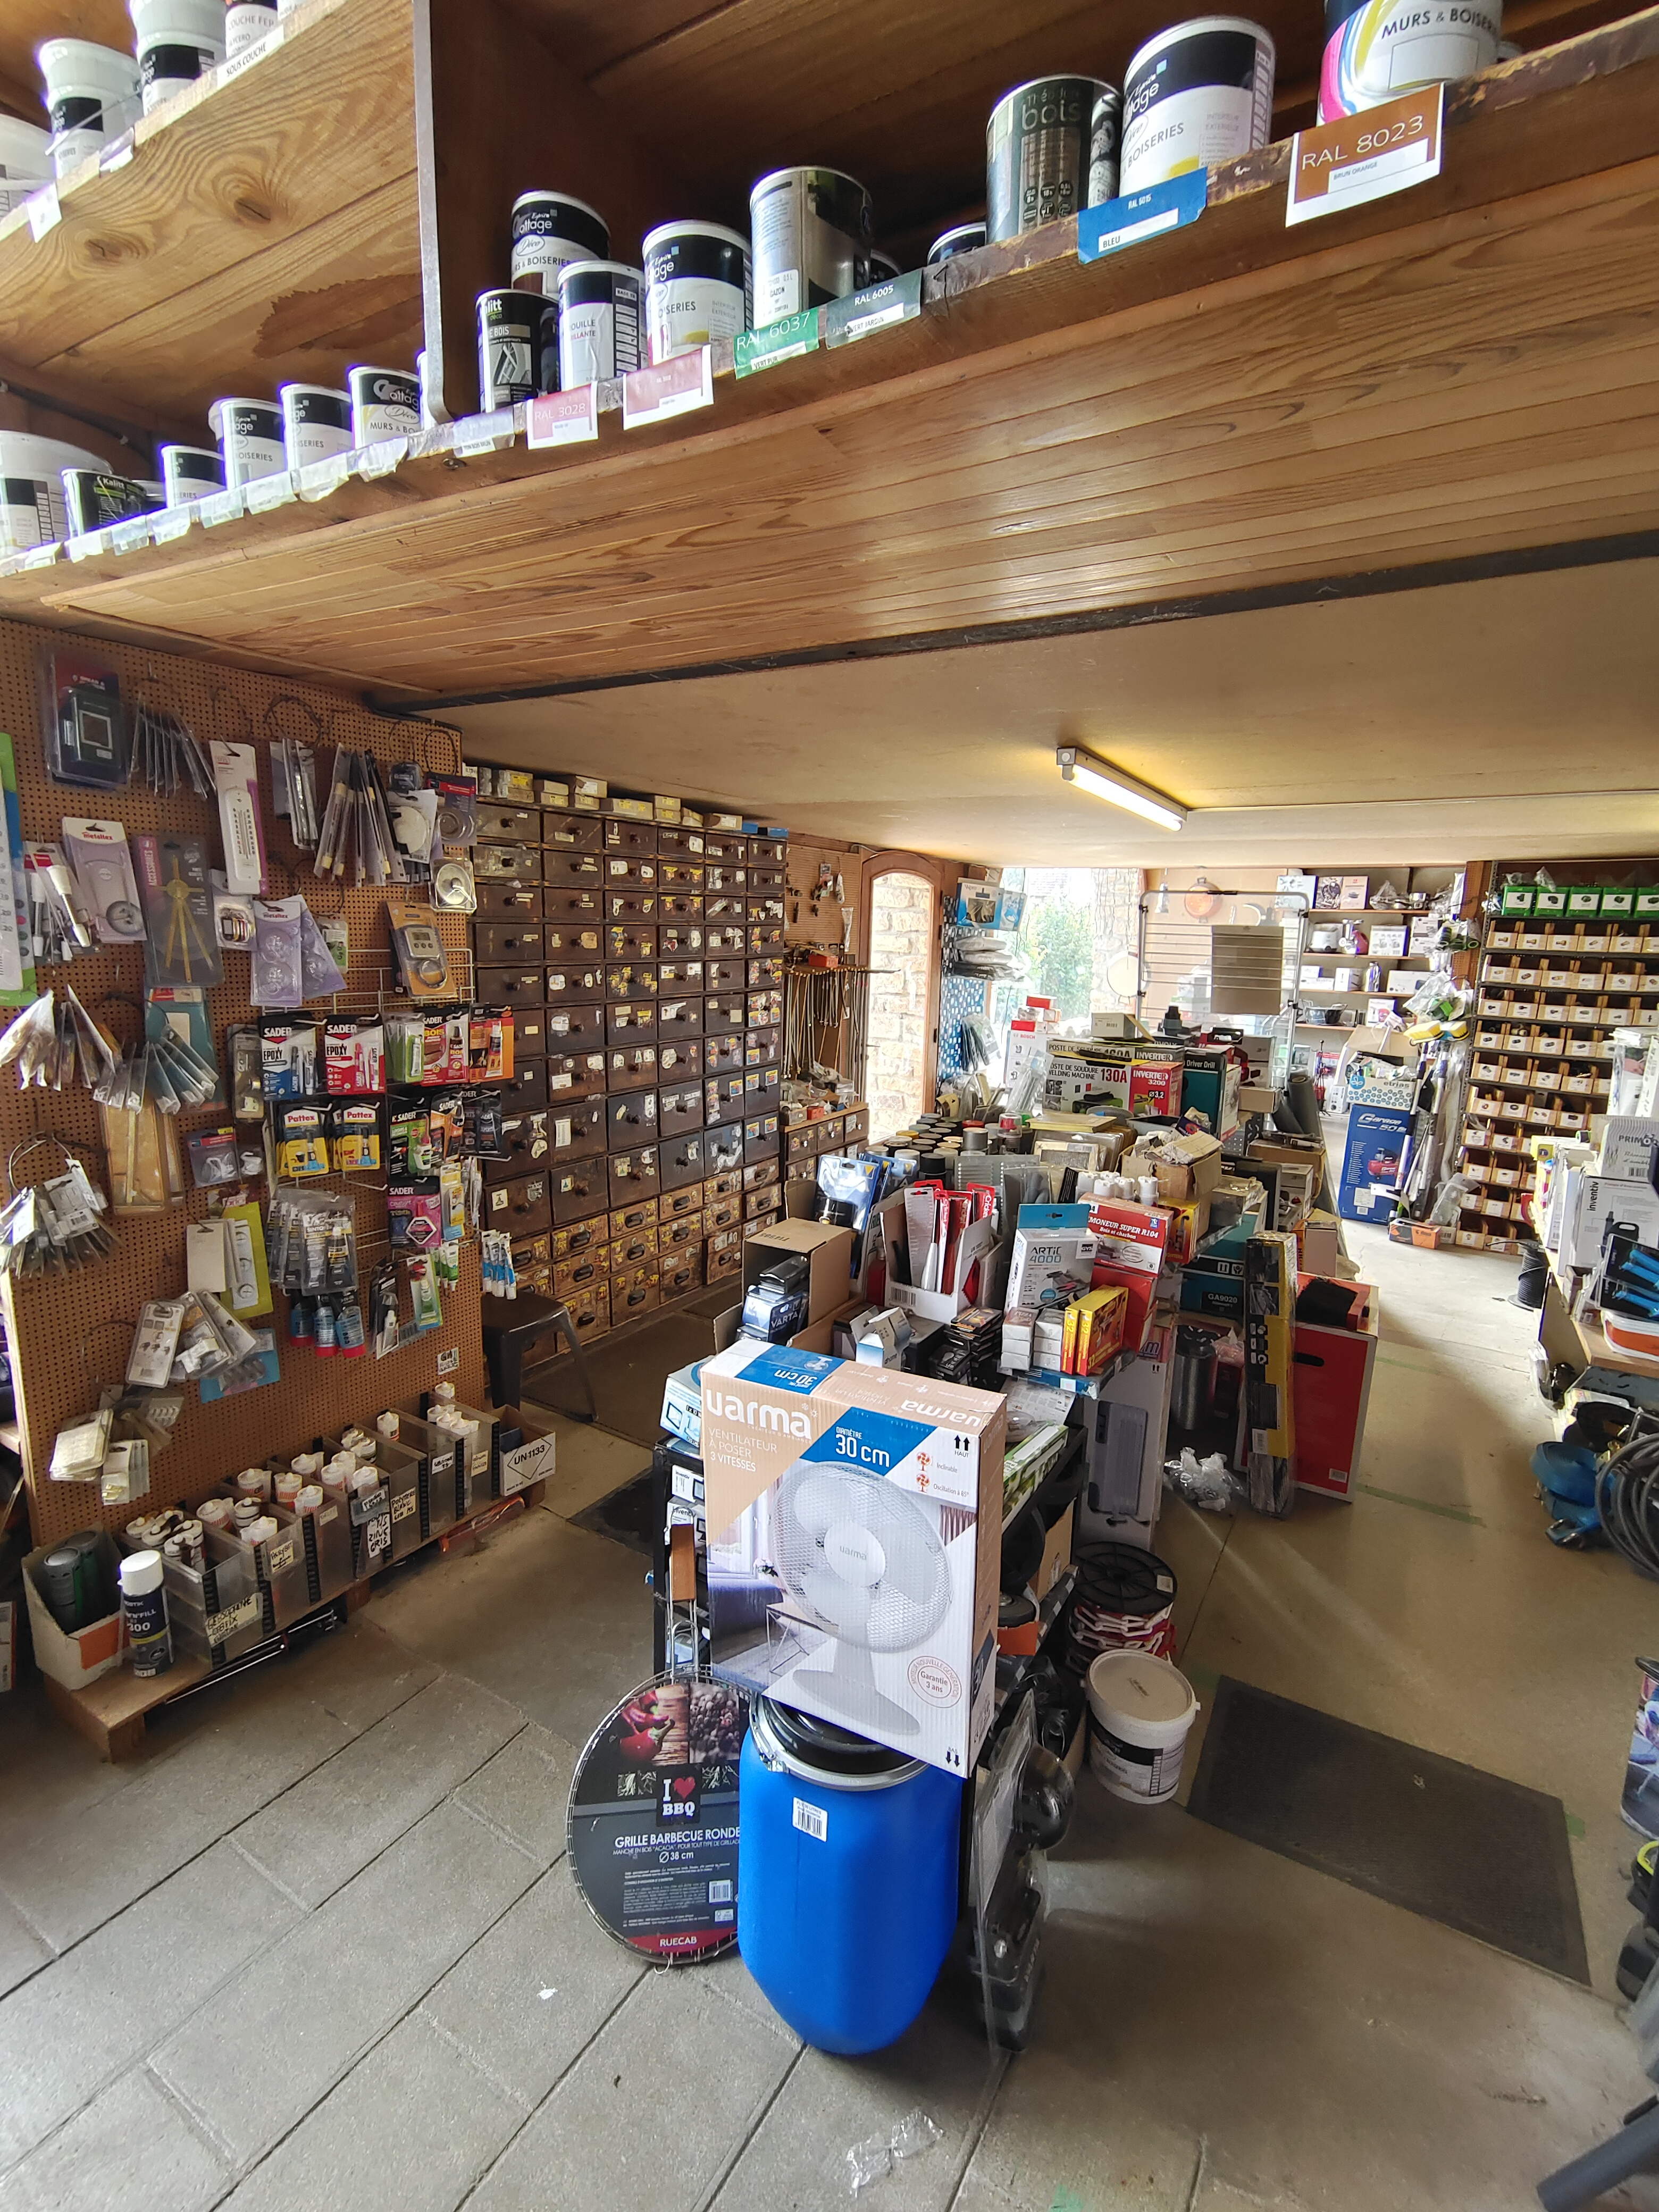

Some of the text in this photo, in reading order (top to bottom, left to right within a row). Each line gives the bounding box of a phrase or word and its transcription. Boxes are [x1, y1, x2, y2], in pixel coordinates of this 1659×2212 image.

[1381, 10, 1445, 40] MURS &
[226, 59, 242, 77] SOUS
[242, 42, 266, 66] COUCHE
[1022, 98, 1081, 131] bois
[1128, 122, 1185, 171] BOISERIES
[1301, 114, 1423, 171] RAL 8023
[1333, 161, 1378, 181] BRUN ORANGE
[1128, 198, 1138, 210] RAL
[1102, 235, 1121, 249] BLEU
[854, 283, 894, 306] RAL 6005
[494, 326, 510, 336] BOIS
[737, 332, 764, 351] RAL
[769, 311, 810, 339] 6037
[850, 323, 864, 333] VERT
[753, 355, 778, 370] VERT PUR
[534, 403, 585, 422] RAL 3028
[370, 422, 393, 431] MURS
[263, 1026, 292, 1038] SADER
[326, 1024, 357, 1034] SADER
[263, 1046, 283, 1061] EPOXY
[326, 1043, 347, 1056] EPOXY
[1136, 1051, 1174, 1062] INVERTER
[1186, 1060, 1202, 1069] Driver
[1071, 1071, 1096, 1080] MACHINE
[1101, 1068, 1127, 1084] 130A
[1133, 1069, 1169, 1080] INVERTER
[439, 1100, 456, 1112] SADER
[397, 1111, 416, 1122] SADER
[877, 1176, 909, 1187] ARTA
[389, 1187, 414, 1195] SADER
[1587, 1180, 1599, 1211] inventiv
[1116, 1231, 1137, 1239] charbon
[1119, 1224, 1141, 1234] SUPER
[1141, 1229, 1159, 1239] R104
[1029, 1255, 1062, 1263] 4000
[1208, 1293, 1238, 1303] GA9020
[770, 1311, 798, 1329] VARTA
[774, 1368, 818, 1386] 30 cm
[835, 1426, 863, 1439] DIAMÈTRE
[708, 1426, 778, 1454] VENTILATEUR
[709, 1438, 752, 1459] À POSER
[835, 1434, 891, 1468] 30 cm
[710, 1451, 756, 1472] 3 VITESSES
[936, 1462, 958, 1473] Inclinable
[933, 1483, 957, 1495] Oscillation
[371, 1537, 388, 1552] GRIS
[917, 1658, 944, 1669] NOUVELLE
[920, 1671, 949, 1686] Garantie
[931, 1683, 943, 1693] ans
[663, 1778, 672, 1802] I
[662, 1801, 696, 1817] BBQ
[614, 1834, 649, 1849] GRILLE
[650, 1830, 703, 1846] BARBECUE
[613, 1848, 634, 1856] MANCHE
[670, 1851, 694, 1861] 38 cm
[659, 1936, 698, 1948] RUECAB
